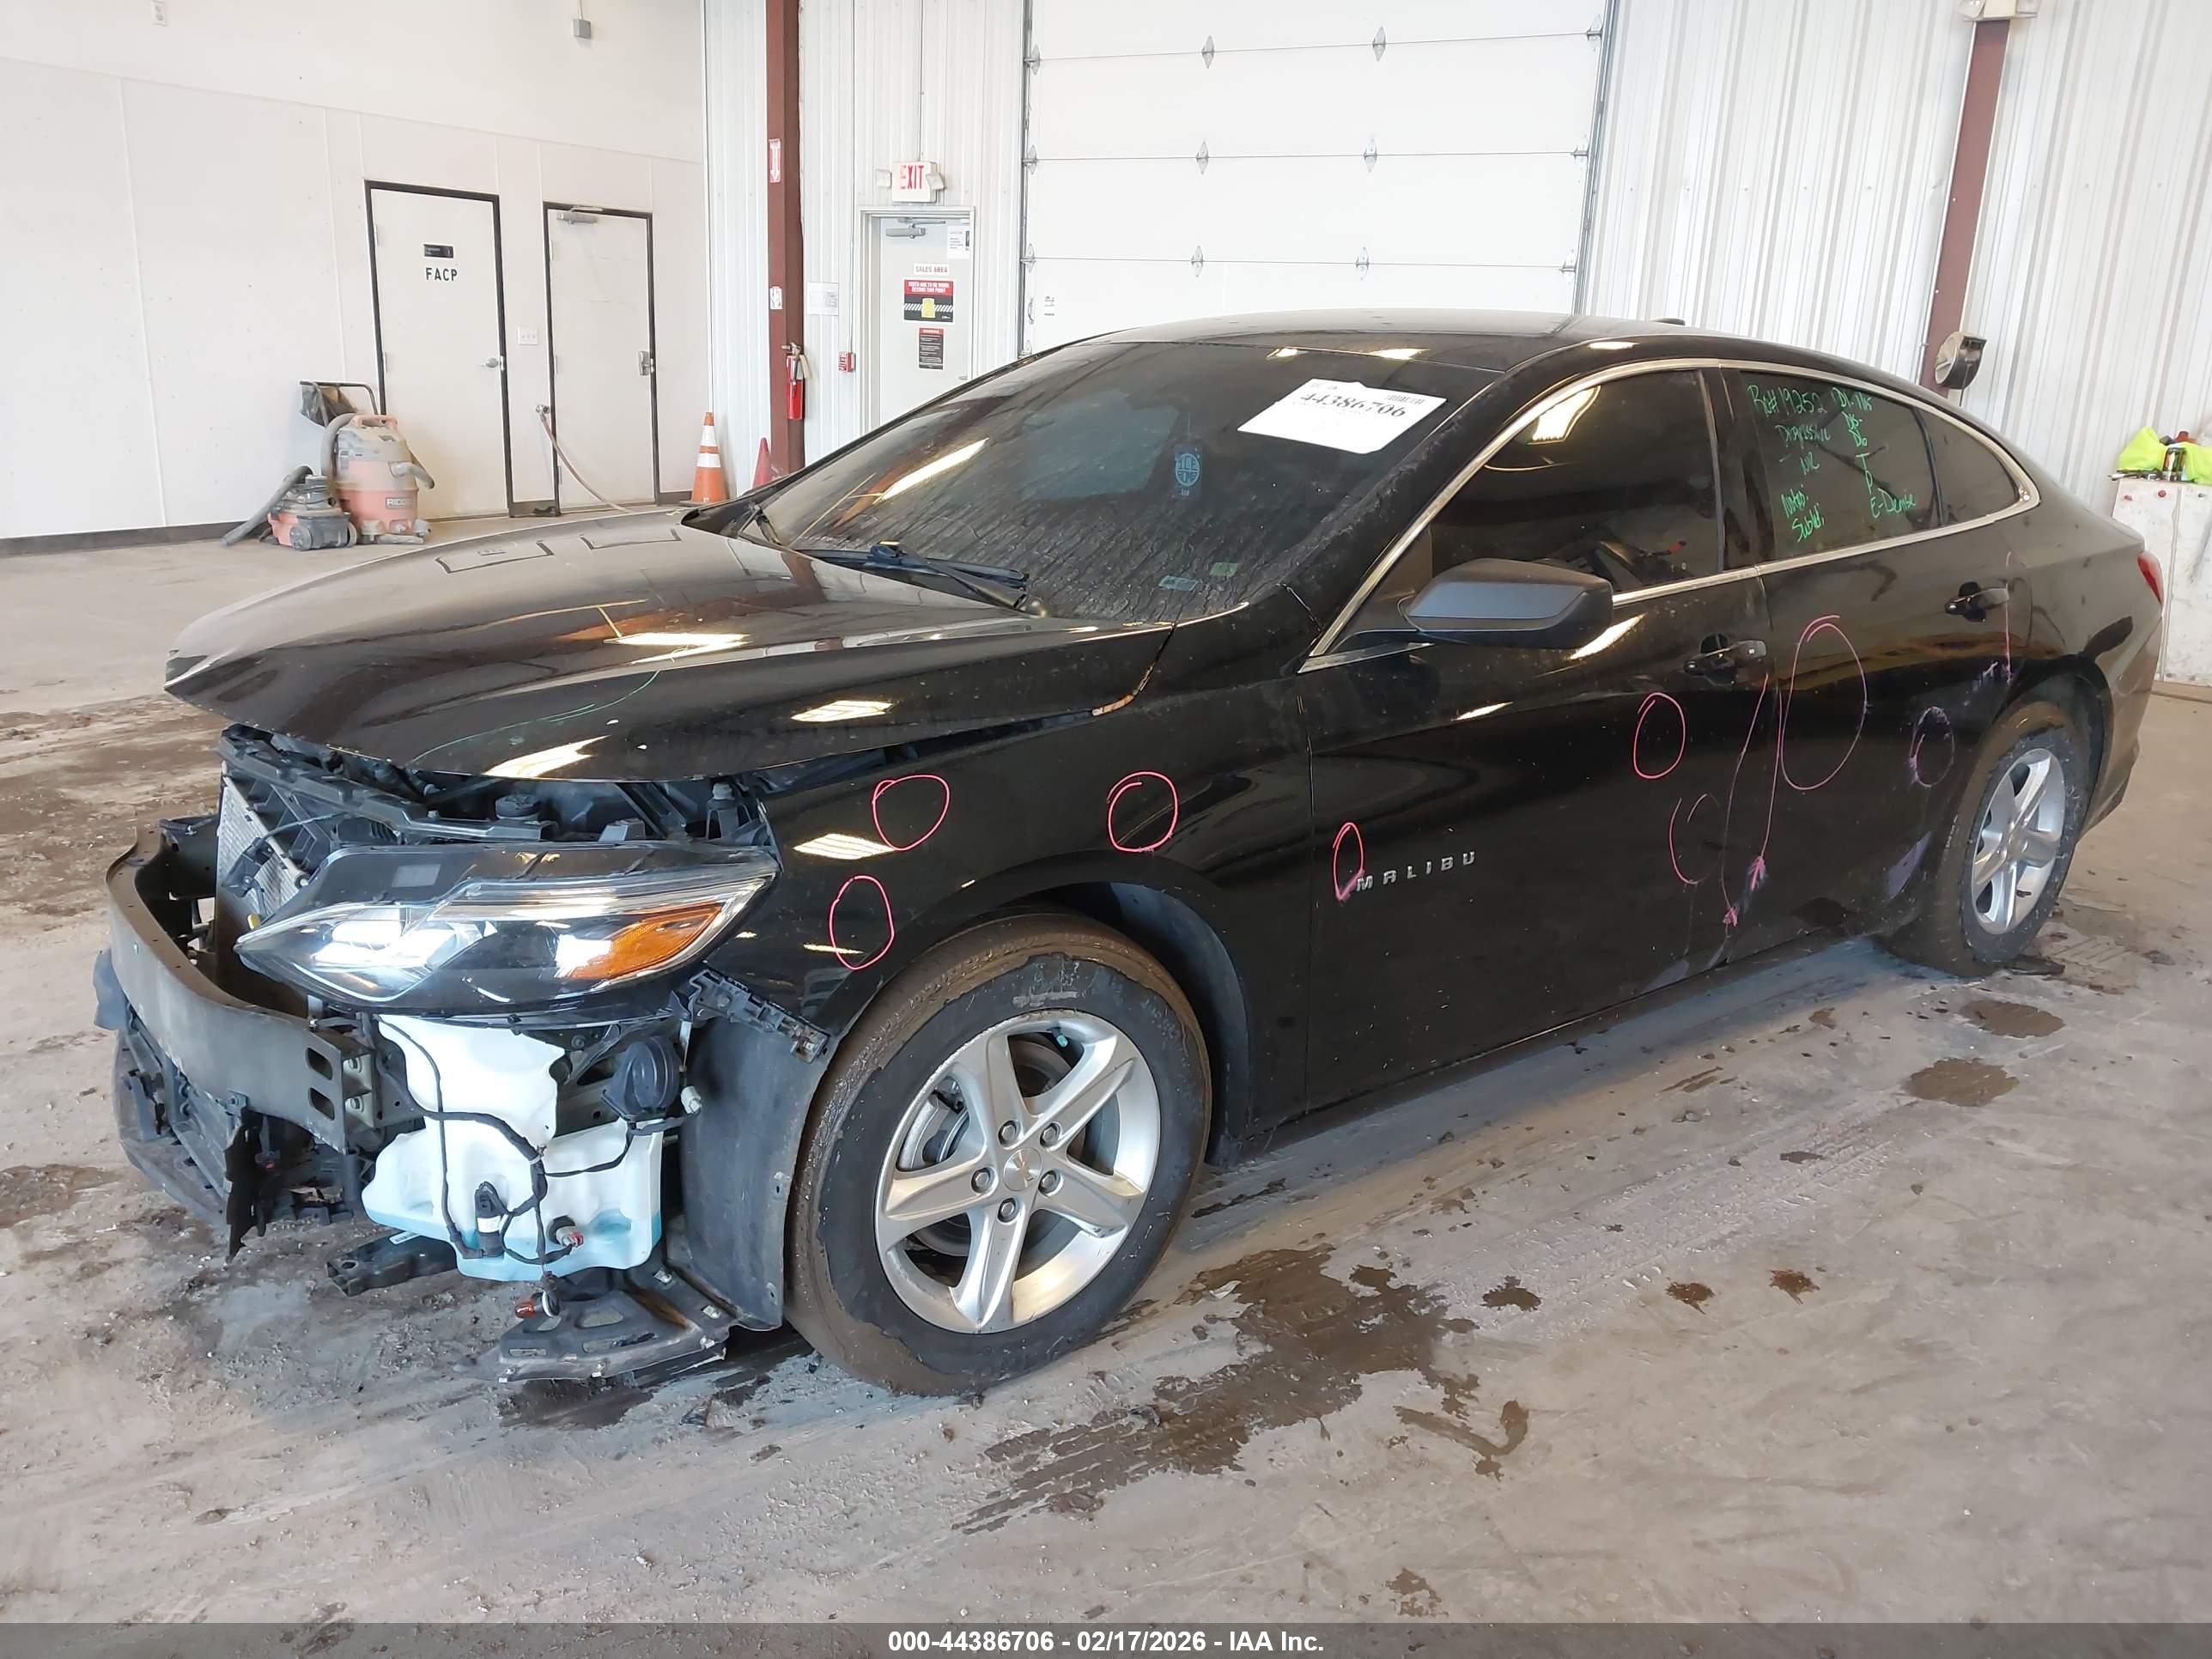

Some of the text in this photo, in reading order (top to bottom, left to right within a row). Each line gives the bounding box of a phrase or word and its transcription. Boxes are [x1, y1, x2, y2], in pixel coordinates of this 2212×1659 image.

[900, 164, 924, 190] EXIT
[425, 267, 458, 282] FACP
[1300, 393, 1407, 417] 44386706
[1356, 851, 1475, 892] MALIBU
